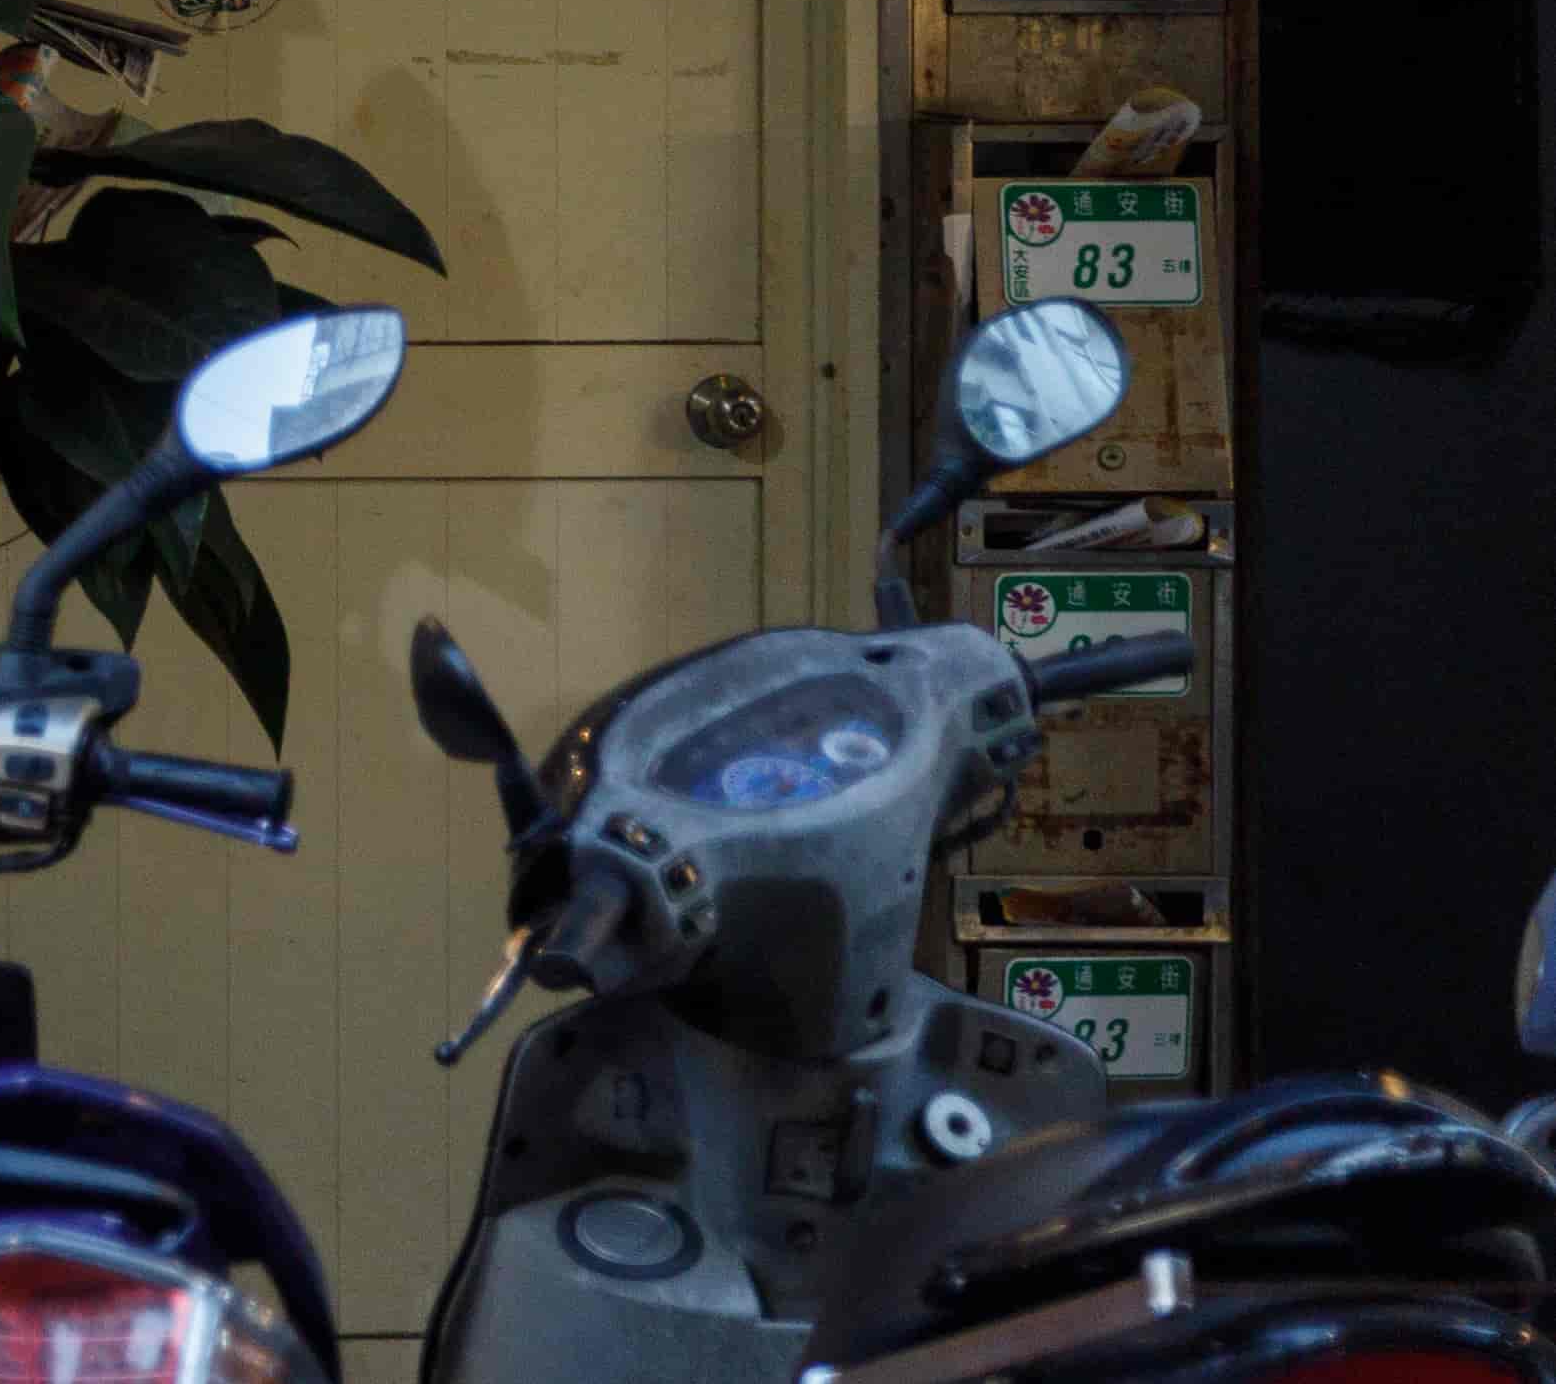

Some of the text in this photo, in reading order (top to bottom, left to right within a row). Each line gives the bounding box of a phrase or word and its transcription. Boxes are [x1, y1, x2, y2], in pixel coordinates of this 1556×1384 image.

[1073, 191, 1187, 217] 通安街
[1073, 243, 1134, 289] 83
[1067, 580, 1178, 608] 通安街
[1074, 964, 1183, 992] 通安街
